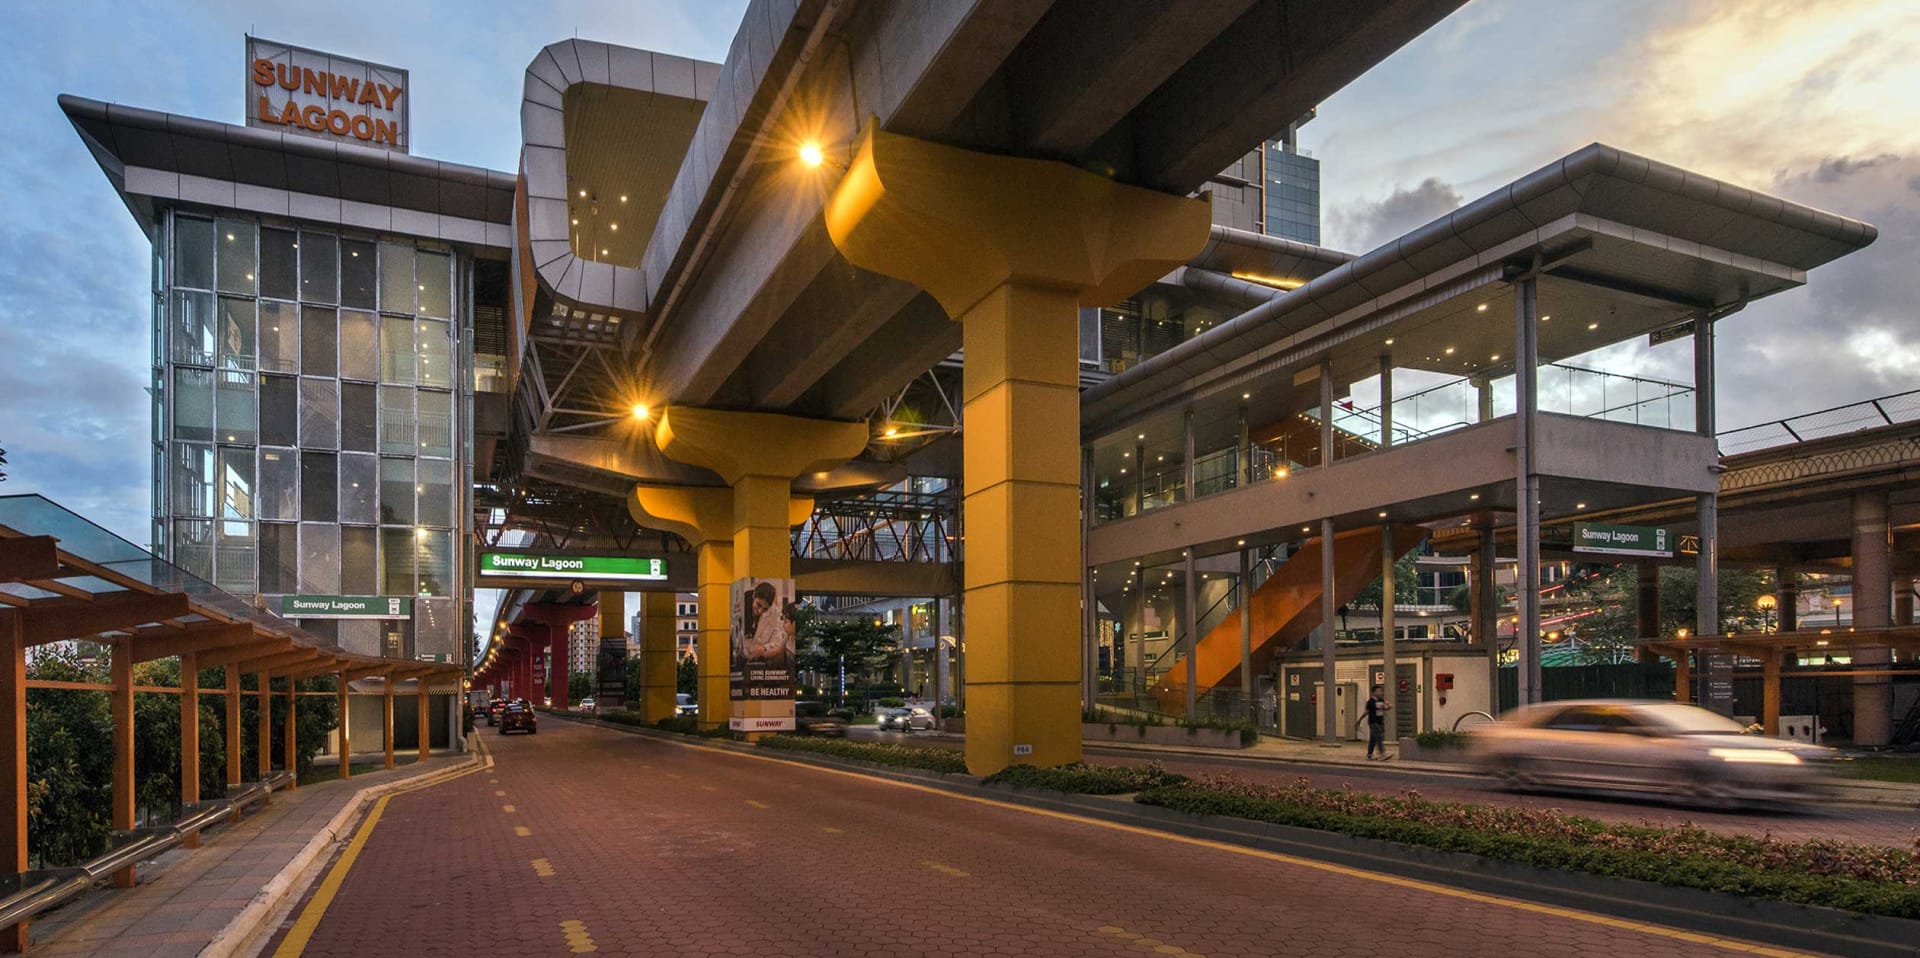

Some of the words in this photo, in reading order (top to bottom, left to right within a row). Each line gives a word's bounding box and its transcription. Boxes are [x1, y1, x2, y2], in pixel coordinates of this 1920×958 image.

[253, 59, 402, 111] SUNWAY
[259, 96, 398, 146] LAGOON
[1582, 528, 1611, 543] Sunway
[1612, 530, 1639, 543] Lagoon
[492, 555, 539, 570] Sunway
[541, 557, 584, 570] Lagoon
[293, 600, 331, 610] Sunway
[332, 601, 366, 610] Lagoon
[750, 687, 760, 697] BE
[760, 687, 790, 697] HEALTHY
[756, 720, 782, 728] SUNWAY
